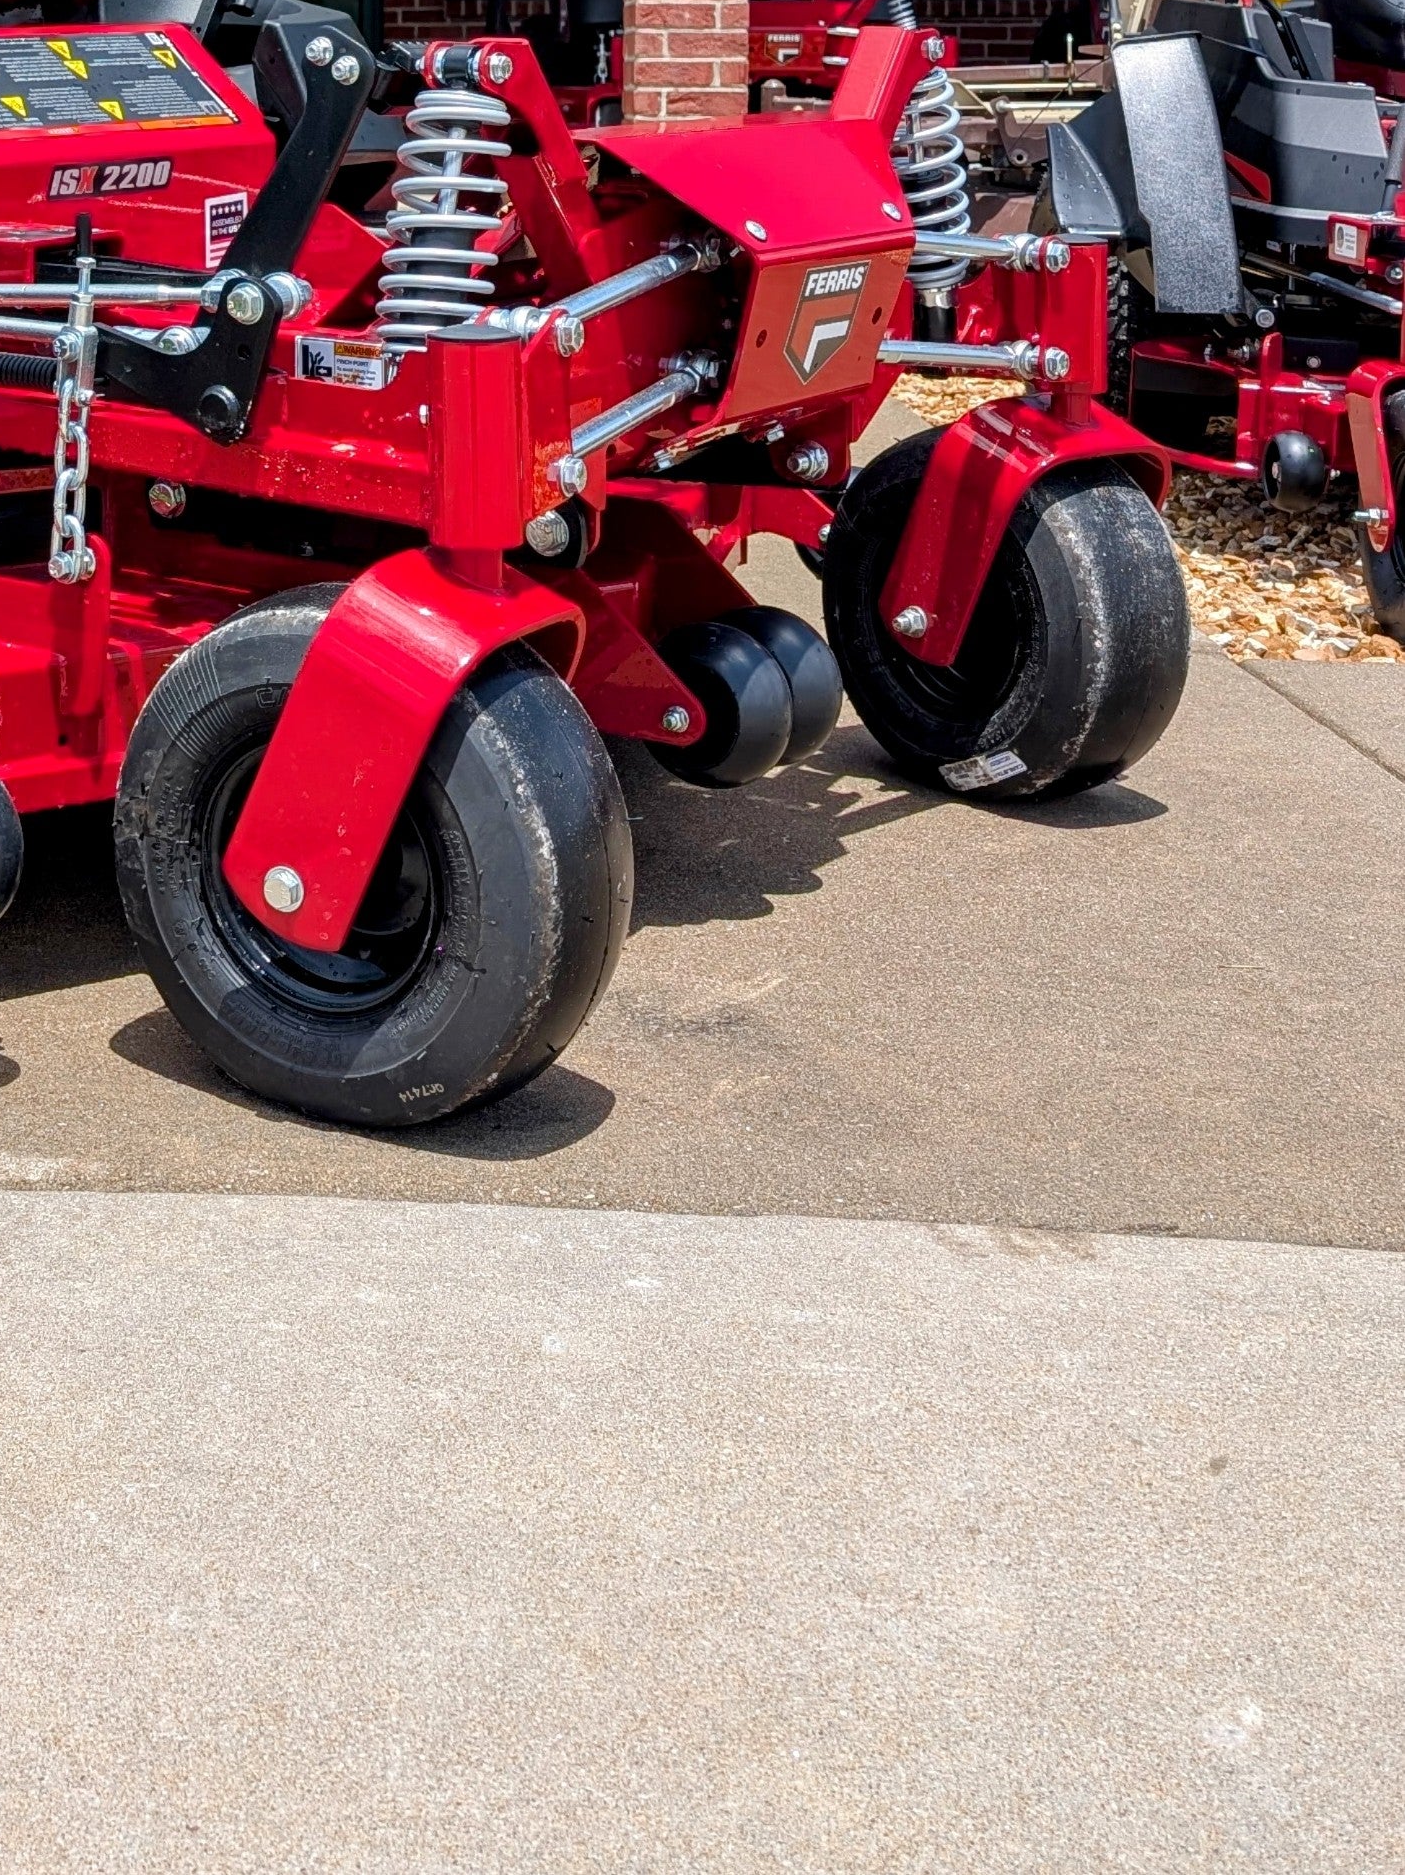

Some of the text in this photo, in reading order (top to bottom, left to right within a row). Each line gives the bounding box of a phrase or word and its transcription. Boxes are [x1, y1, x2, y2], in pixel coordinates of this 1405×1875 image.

[49, 160, 171, 196] ISX 2200
[211, 215, 243, 228] ASSEMBLED
[804, 265, 865, 297] FERRIS
[344, 344, 381, 357] WARNING
